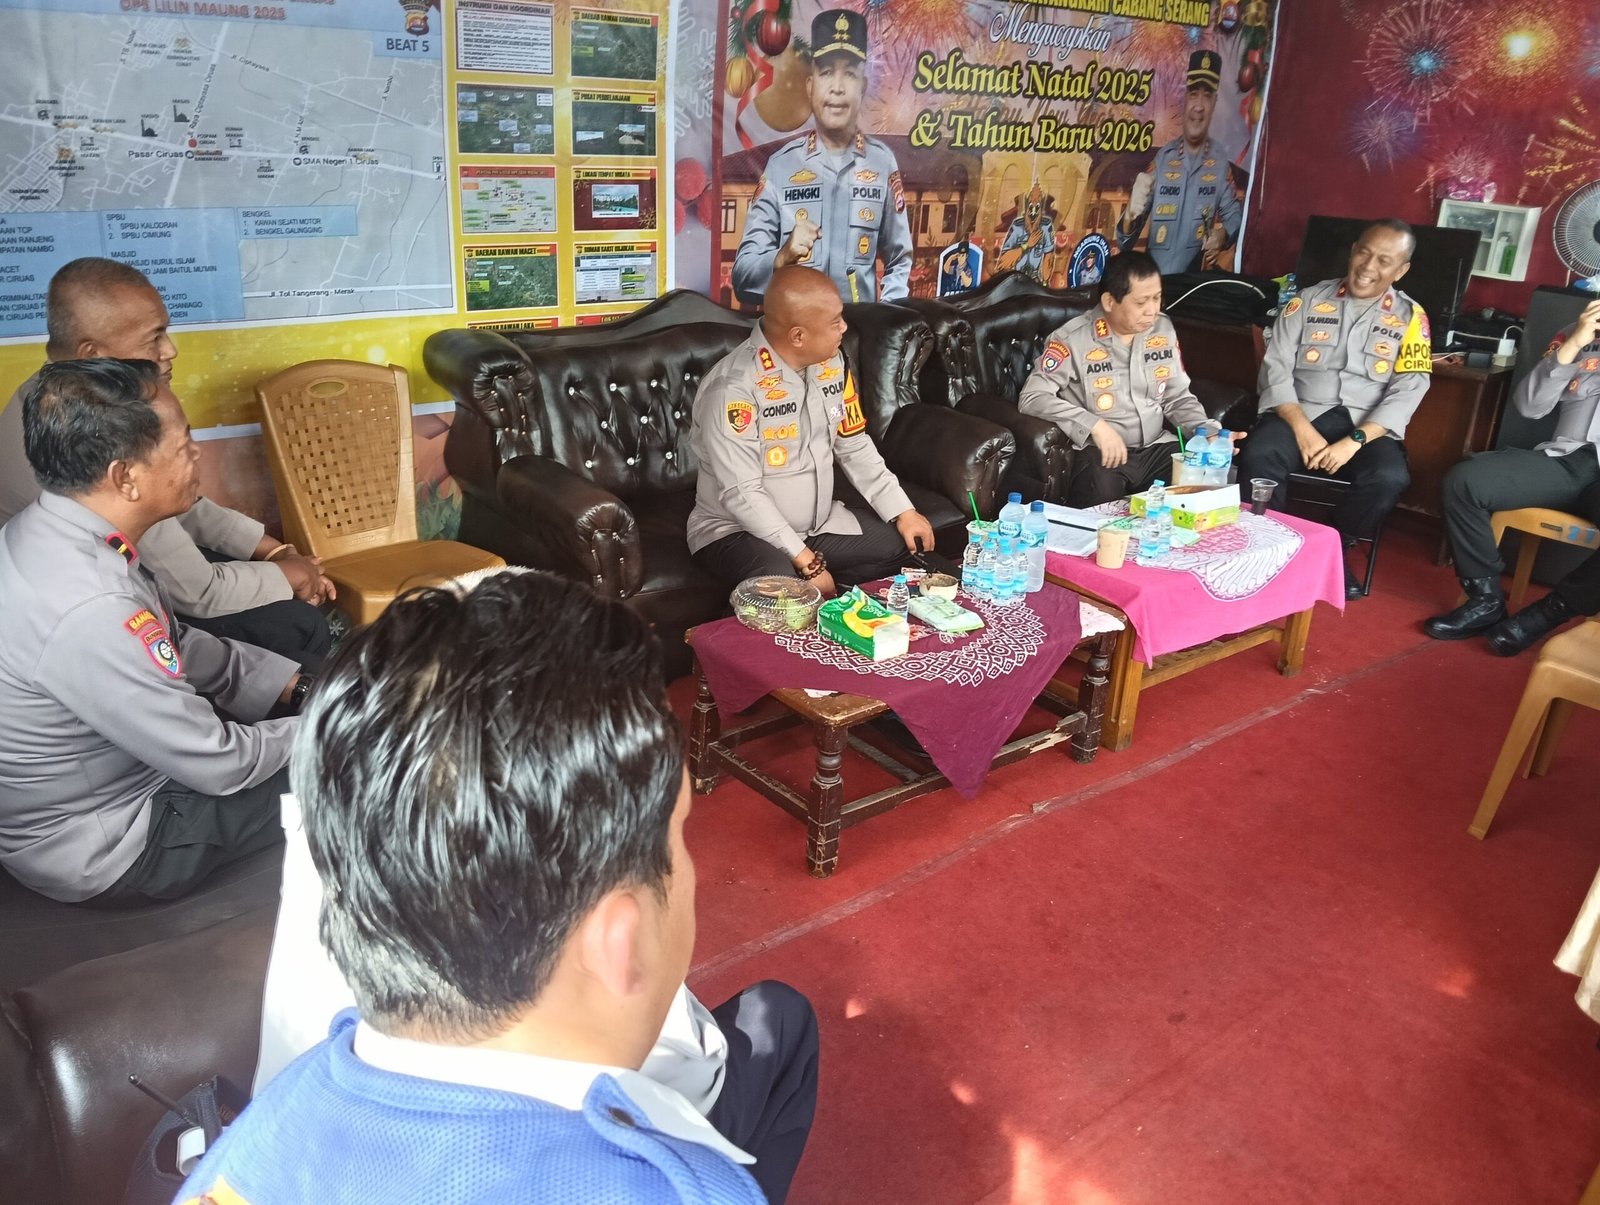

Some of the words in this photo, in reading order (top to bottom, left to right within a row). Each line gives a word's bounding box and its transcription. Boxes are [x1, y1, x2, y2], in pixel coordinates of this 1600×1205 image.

[120, 0, 149, 11] OPS
[155, 1, 189, 14] LILIN
[194, 3, 249, 17] MAUNG
[254, 6, 286, 20] 2025
[458, 1, 492, 9] INSTRUKSI
[493, 3, 509, 11] DAN
[510, 5, 550, 14] KOORDINASI
[1112, 0, 1163, 20] CABANG
[1165, 3, 1210, 26] SERANG
[989, 2, 1111, 60] Mengucapkan
[386, 38, 418, 51] BEAT
[422, 41, 429, 52] 5
[914, 49, 1022, 96] Selamat
[1026, 62, 1098, 99] Natal
[1097, 69, 1154, 104] 2025
[910, 109, 942, 149] &
[949, 110, 1034, 150] Tahun
[1035, 117, 1095, 151] Baru
[1097, 119, 1154, 152] 2026
[128, 150, 153, 158] Pasar
[156, 150, 184, 158] Ciruas
[322, 158, 346, 166] Negeri
[785, 187, 820, 201] HENGKI
[852, 187, 881, 200] POLRI
[1160, 185, 1180, 196] CONDRO
[242, 210, 272, 218] BENGKEL
[120, 222, 139, 230] SPBU
[121, 231, 140, 239] SPBU
[255, 228, 284, 236] BENGKEL
[27, 245, 54, 253] NAMBO
[475, 248, 497, 256] DAERAH
[518, 247, 537, 255] MACET
[151, 258, 173, 266] NURUL
[175, 257, 195, 265] ISLAM
[6, 274, 35, 283] CIRUAS
[292, 289, 329, 298] Tangerang
[11, 303, 39, 311] CIRUAS
[6, 312, 34, 321] CIRUAS
[1144, 349, 1173, 363] POLRI
[1086, 362, 1113, 375] ADHI
[763, 402, 797, 418] CONDRO
